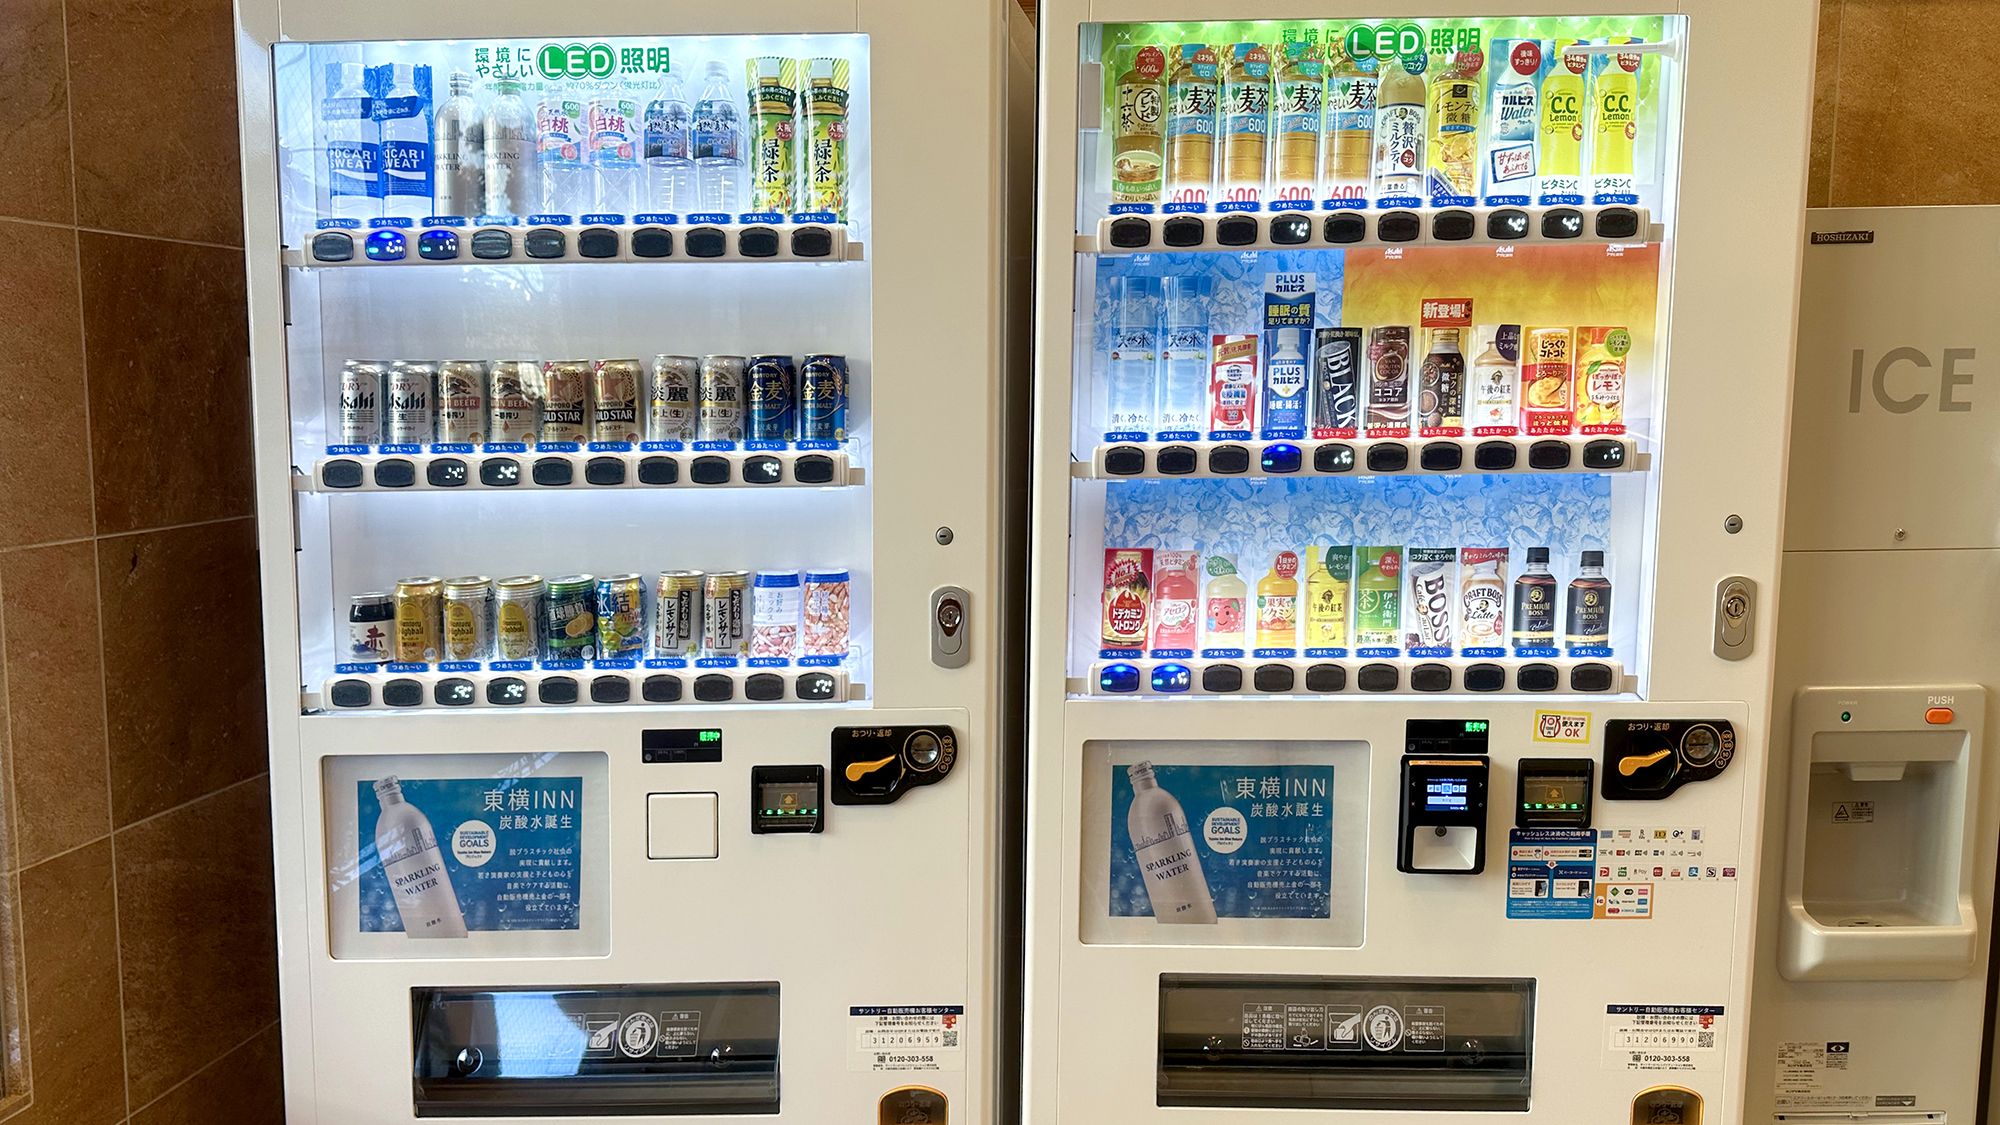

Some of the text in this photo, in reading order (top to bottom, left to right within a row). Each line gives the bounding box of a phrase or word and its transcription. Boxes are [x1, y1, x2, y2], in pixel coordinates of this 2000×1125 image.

[1353, 31, 1419, 55] LED
[1430, 27, 1481, 54] 照明
[544, 49, 610, 73] LED
[620, 47, 670, 73] 照明
[475, 63, 533, 79] やさしい
[1187, 86, 1217, 115] 麦茶
[1240, 85, 1269, 113] 麦茶
[1293, 84, 1321, 112] 麦茶
[1349, 81, 1378, 109] 麦茶
[1502, 95, 1534, 106] カルピス
[1121, 87, 1134, 134] 十六茶
[1551, 96, 1579, 114] C.C.
[1603, 95, 1632, 113] C.C.
[1445, 112, 1471, 124] 微糖
[1501, 106, 1535, 121] Water
[1549, 113, 1577, 122] Lemon
[1602, 112, 1630, 121] Lemon
[541, 117, 569, 134] 白桃
[596, 116, 625, 133] 白桃
[1196, 119, 1214, 133] 600
[1248, 118, 1266, 133] 600
[1302, 117, 1319, 131] 600
[1357, 115, 1374, 128] 600
[1390, 121, 1415, 171] 贅沢 ミルクティー
[763, 139, 779, 183] 緑茶
[814, 139, 831, 183] 緑茶
[1541, 179, 1578, 190] ビタミンC
[1594, 178, 1631, 189] ビタミンC
[1816, 233, 1869, 242] HOSHIZAKI
[1275, 274, 1305, 284] PLUS
[1275, 284, 1305, 293] カルピス
[1268, 303, 1311, 317] 睡眠の質
[1422, 301, 1466, 319] 新登場!
[1268, 317, 1311, 326] 足りてますか?
[1117, 333, 1149, 349] 天然水
[1169, 333, 1201, 348] 天然水
[1541, 340, 1566, 349] じっくり
[1539, 349, 1565, 358] コトコト
[1273, 366, 1301, 376] PLUS
[1273, 376, 1301, 385] カルピス
[1592, 380, 1621, 392] レモン
[1848, 346, 1976, 415] ICE
[651, 386, 689, 402] 淡麗
[701, 386, 737, 402] 淡麗
[750, 381, 783, 402] 金麦
[802, 381, 834, 402] 金麦
[1328, 352, 1356, 429] BLACK
[1374, 387, 1402, 397] ココア
[1480, 384, 1511, 395] 午後の紅茶
[454, 398, 476, 407] BEER
[398, 412, 408, 420] 生
[557, 411, 580, 421] STAR
[610, 410, 633, 420] STAR
[1278, 555, 1296, 565] 1日分の
[1358, 588, 1375, 610] 茶
[1463, 588, 1504, 608] CRAFT BOSS
[1112, 608, 1143, 619] ドデカミン
[1382, 591, 1393, 627] 伊右衛門
[1424, 574, 1451, 642] BOSS
[1521, 602, 1551, 611] PREMIUM
[1575, 606, 1605, 614] PREMIUM
[1470, 610, 1496, 620] Latte
[664, 601, 677, 646] レモンサワー
[717, 601, 729, 647] レモンサワー
[1113, 620, 1141, 631] ストロング
[366, 624, 386, 649] 赤
[1927, 695, 1955, 705] PUSH
[1465, 722, 1487, 733] 販売中
[1562, 720, 1585, 728] 使えます
[1628, 722, 1670, 732] おつり・返却
[851, 728, 893, 738] おつり・返却
[1564, 728, 1581, 738] OK
[1235, 776, 1326, 800] 東横INN
[483, 788, 574, 812] 東横INN
[1250, 802, 1324, 818] 炭酸水誕生
[499, 814, 573, 830] 炭酸水誕生
[1211, 826, 1241, 835] GOALS
[459, 839, 489, 848] GOALS
[1145, 848, 1191, 872] SPARKLING
[394, 863, 441, 889] SPARKLING
[1155, 863, 1189, 882] WATER
[404, 877, 438, 897] WATER
[1616, 1006, 1716, 1014] サントリー自動販売機お客様センター
[1369, 1036, 1398, 1048] リサイクル
[888, 1055, 934, 1063] 0120-303-558
[1644, 1055, 1690, 1063] 0120-303-558
